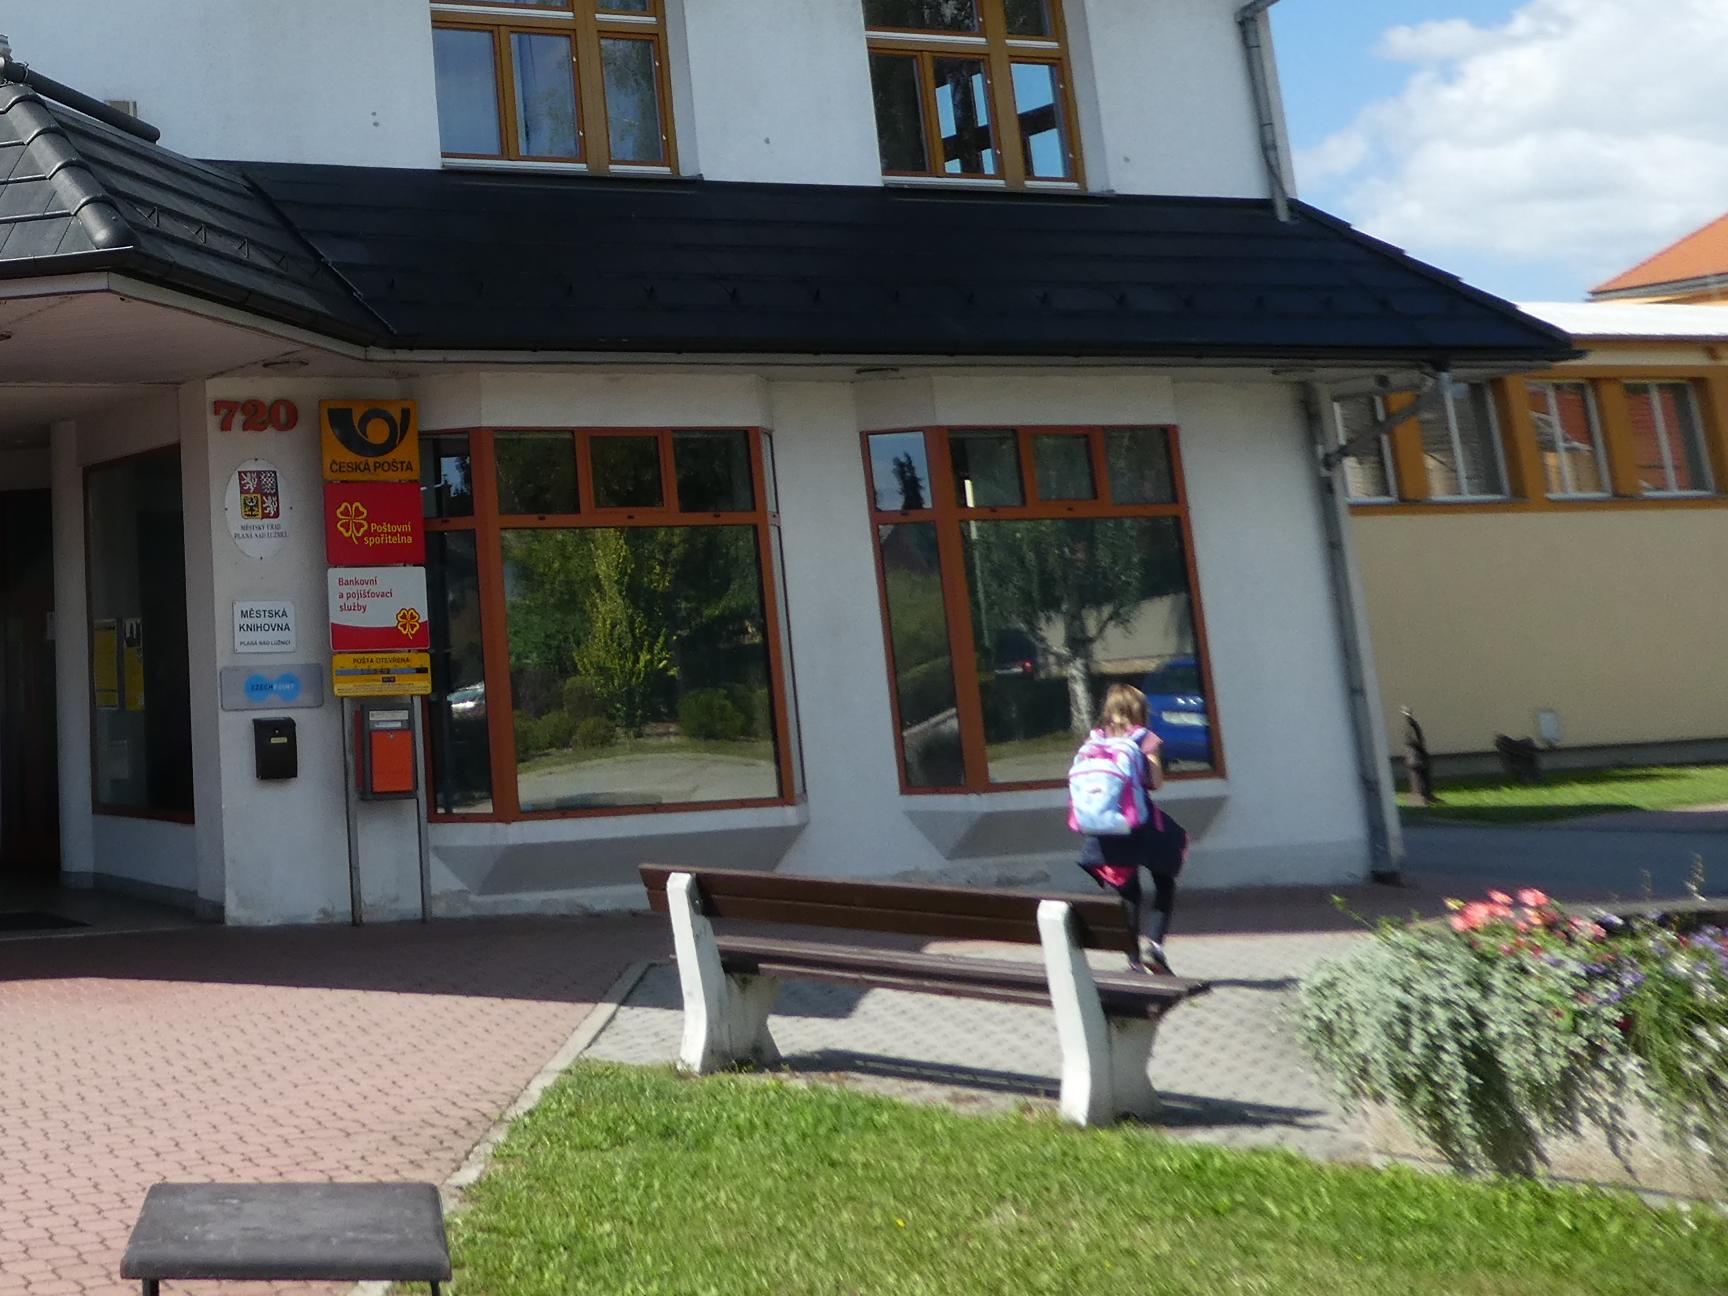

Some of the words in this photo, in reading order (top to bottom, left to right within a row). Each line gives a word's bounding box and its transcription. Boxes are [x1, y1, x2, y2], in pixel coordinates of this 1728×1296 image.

[213, 399, 299, 432] 720
[330, 458, 370, 473] ČESKÁ
[373, 458, 414, 473] POŠTA
[370, 521, 412, 533] Poštovní
[363, 533, 413, 547] spořitelna
[338, 576, 378, 586] Bankovní
[346, 588, 393, 601] pojišťovací
[240, 607, 288, 619] MĚSTSKÁ
[339, 602, 367, 614] služby
[239, 623, 291, 632] KNIHOVNA
